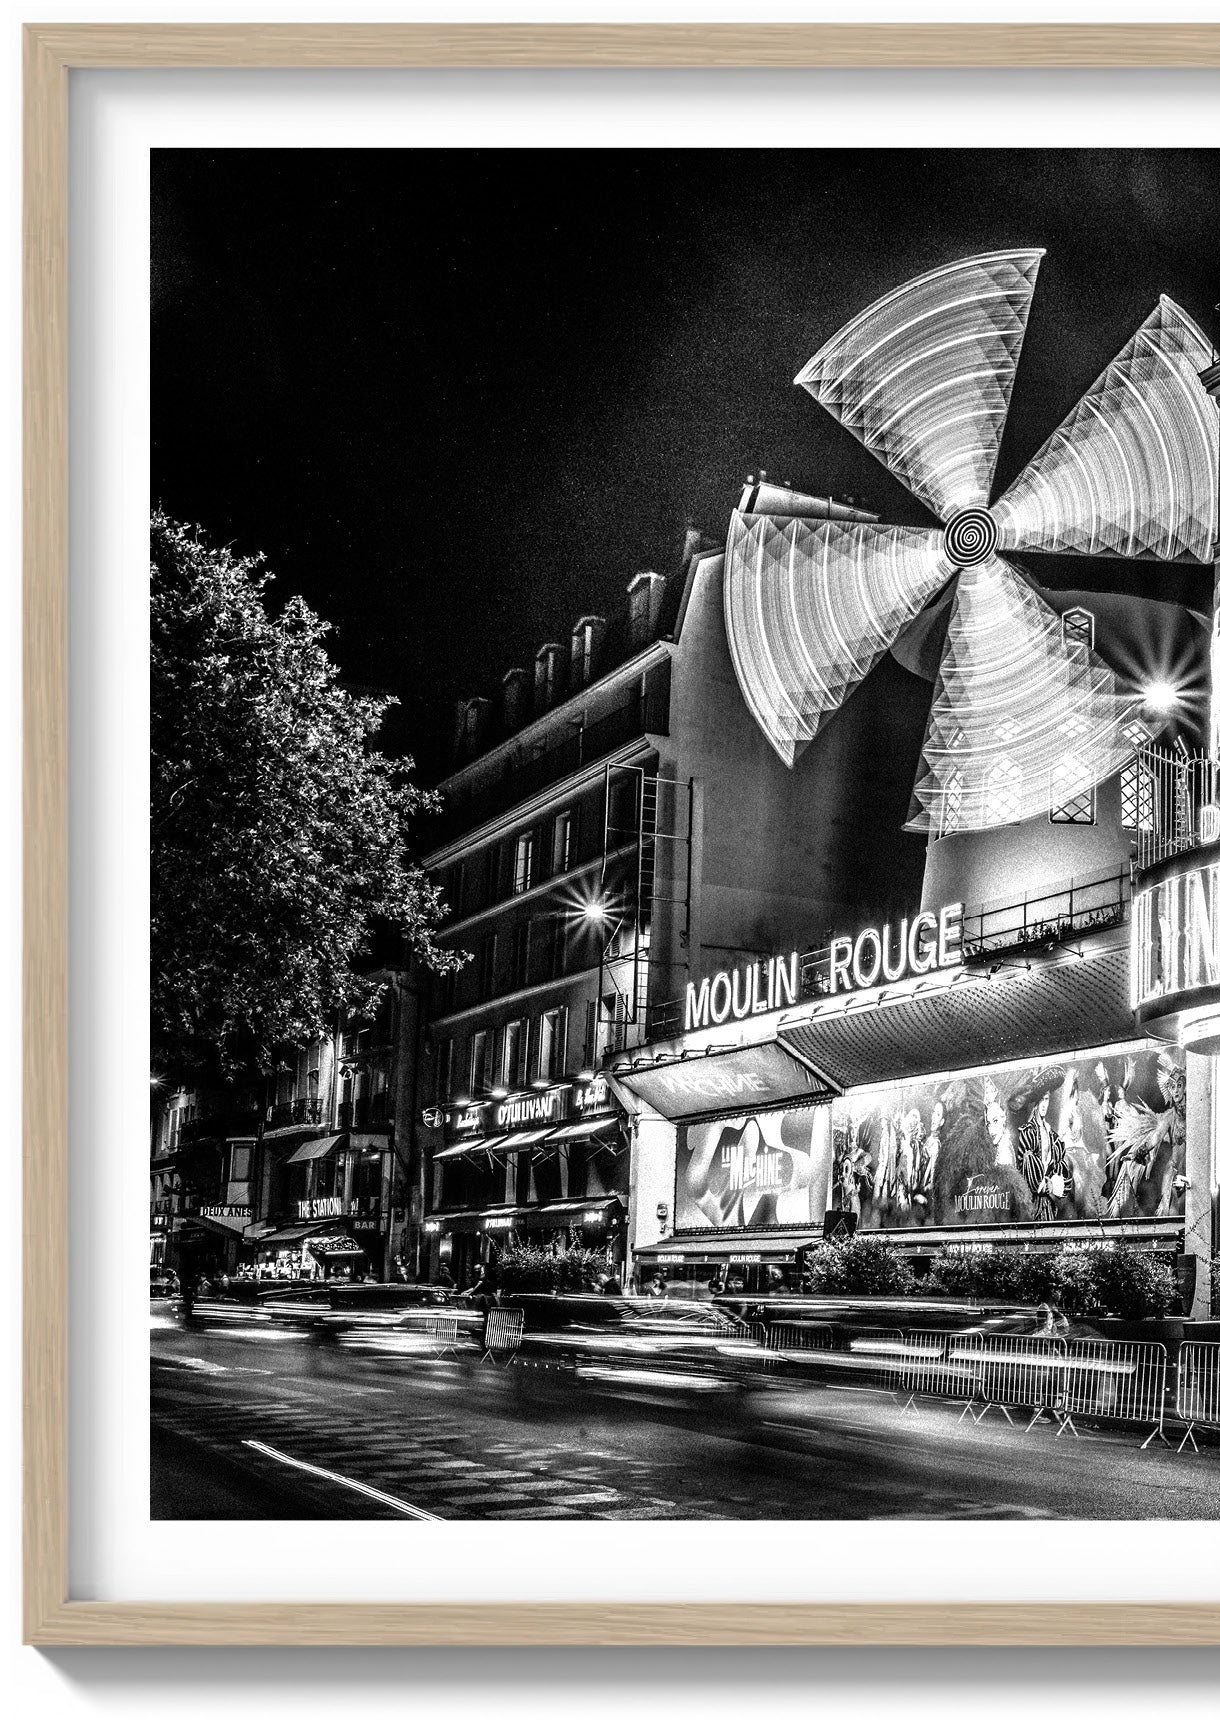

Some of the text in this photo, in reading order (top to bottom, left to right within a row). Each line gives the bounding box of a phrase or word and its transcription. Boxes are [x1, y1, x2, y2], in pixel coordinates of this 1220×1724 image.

[685, 903, 965, 1030] MOULIN ROUGE
[312, 1197, 342, 1218] STATION
[983, 1191, 1010, 1210] ROUGE
[203, 1206, 224, 1216] DEUX
[354, 1221, 375, 1229] BAR
